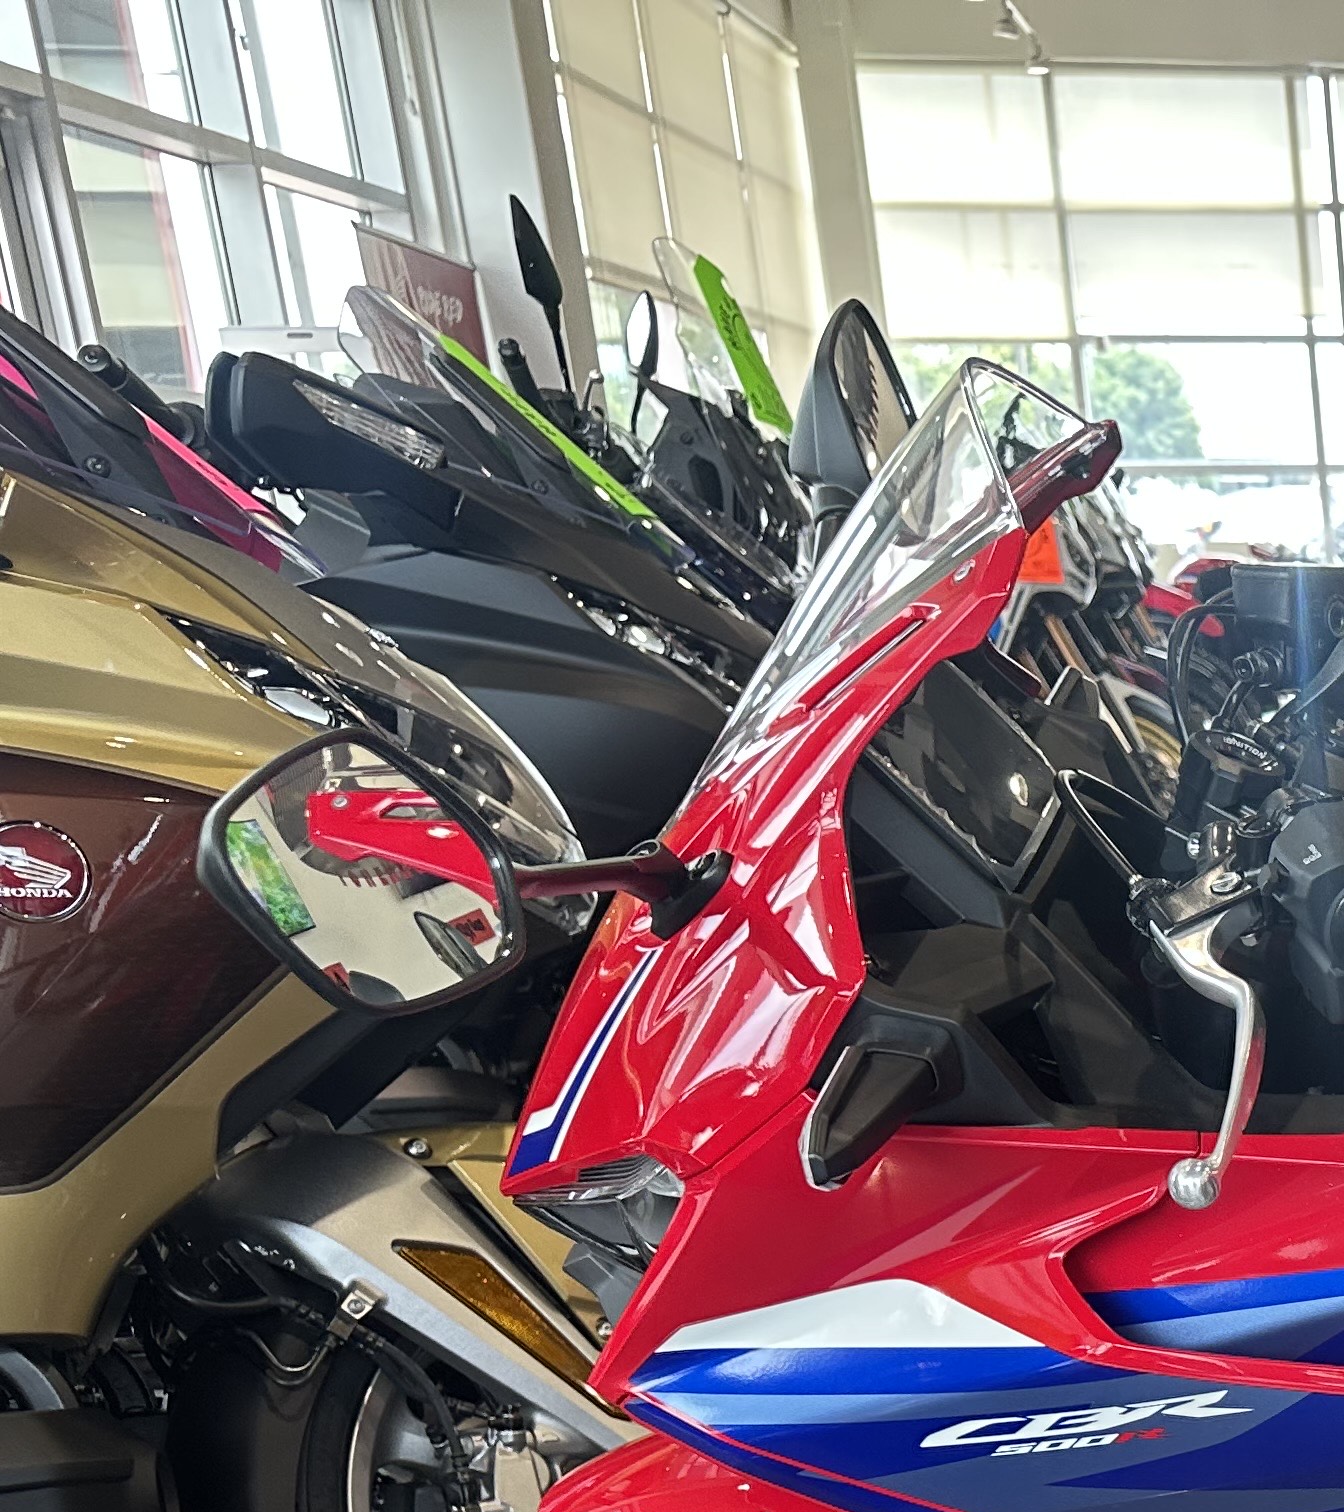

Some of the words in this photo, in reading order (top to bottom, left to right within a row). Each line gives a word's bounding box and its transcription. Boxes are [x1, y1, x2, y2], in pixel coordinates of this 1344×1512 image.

[1223, 735, 1268, 759] IGNITION
[0, 887, 75, 898] HONDA
[920, 1389, 1254, 1448] CBR
[990, 1427, 1168, 1457] 500R
